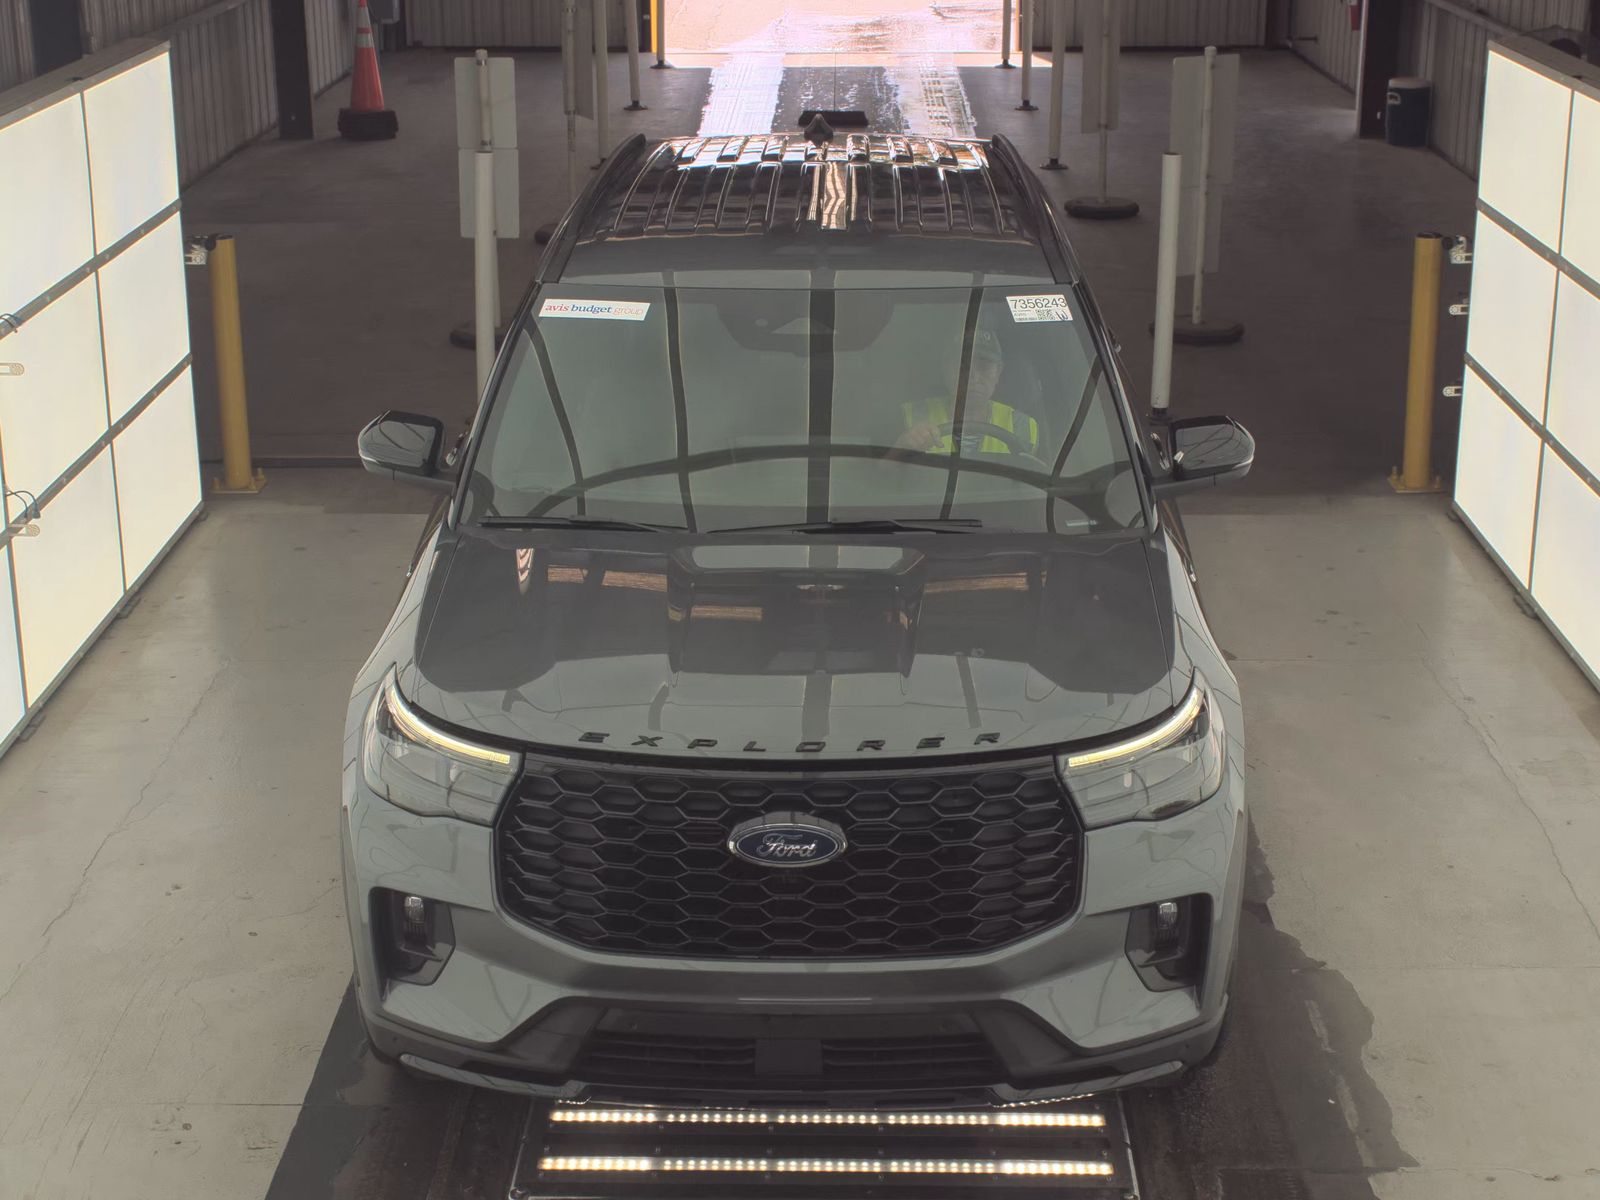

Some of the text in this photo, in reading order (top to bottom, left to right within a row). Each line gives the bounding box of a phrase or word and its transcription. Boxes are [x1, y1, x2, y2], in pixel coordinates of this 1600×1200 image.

[545, 304, 644, 316] avis budget group
[1010, 297, 1067, 309] 7356243
[578, 731, 1001, 753] EXPLORER
[756, 832, 818, 858] Ford
